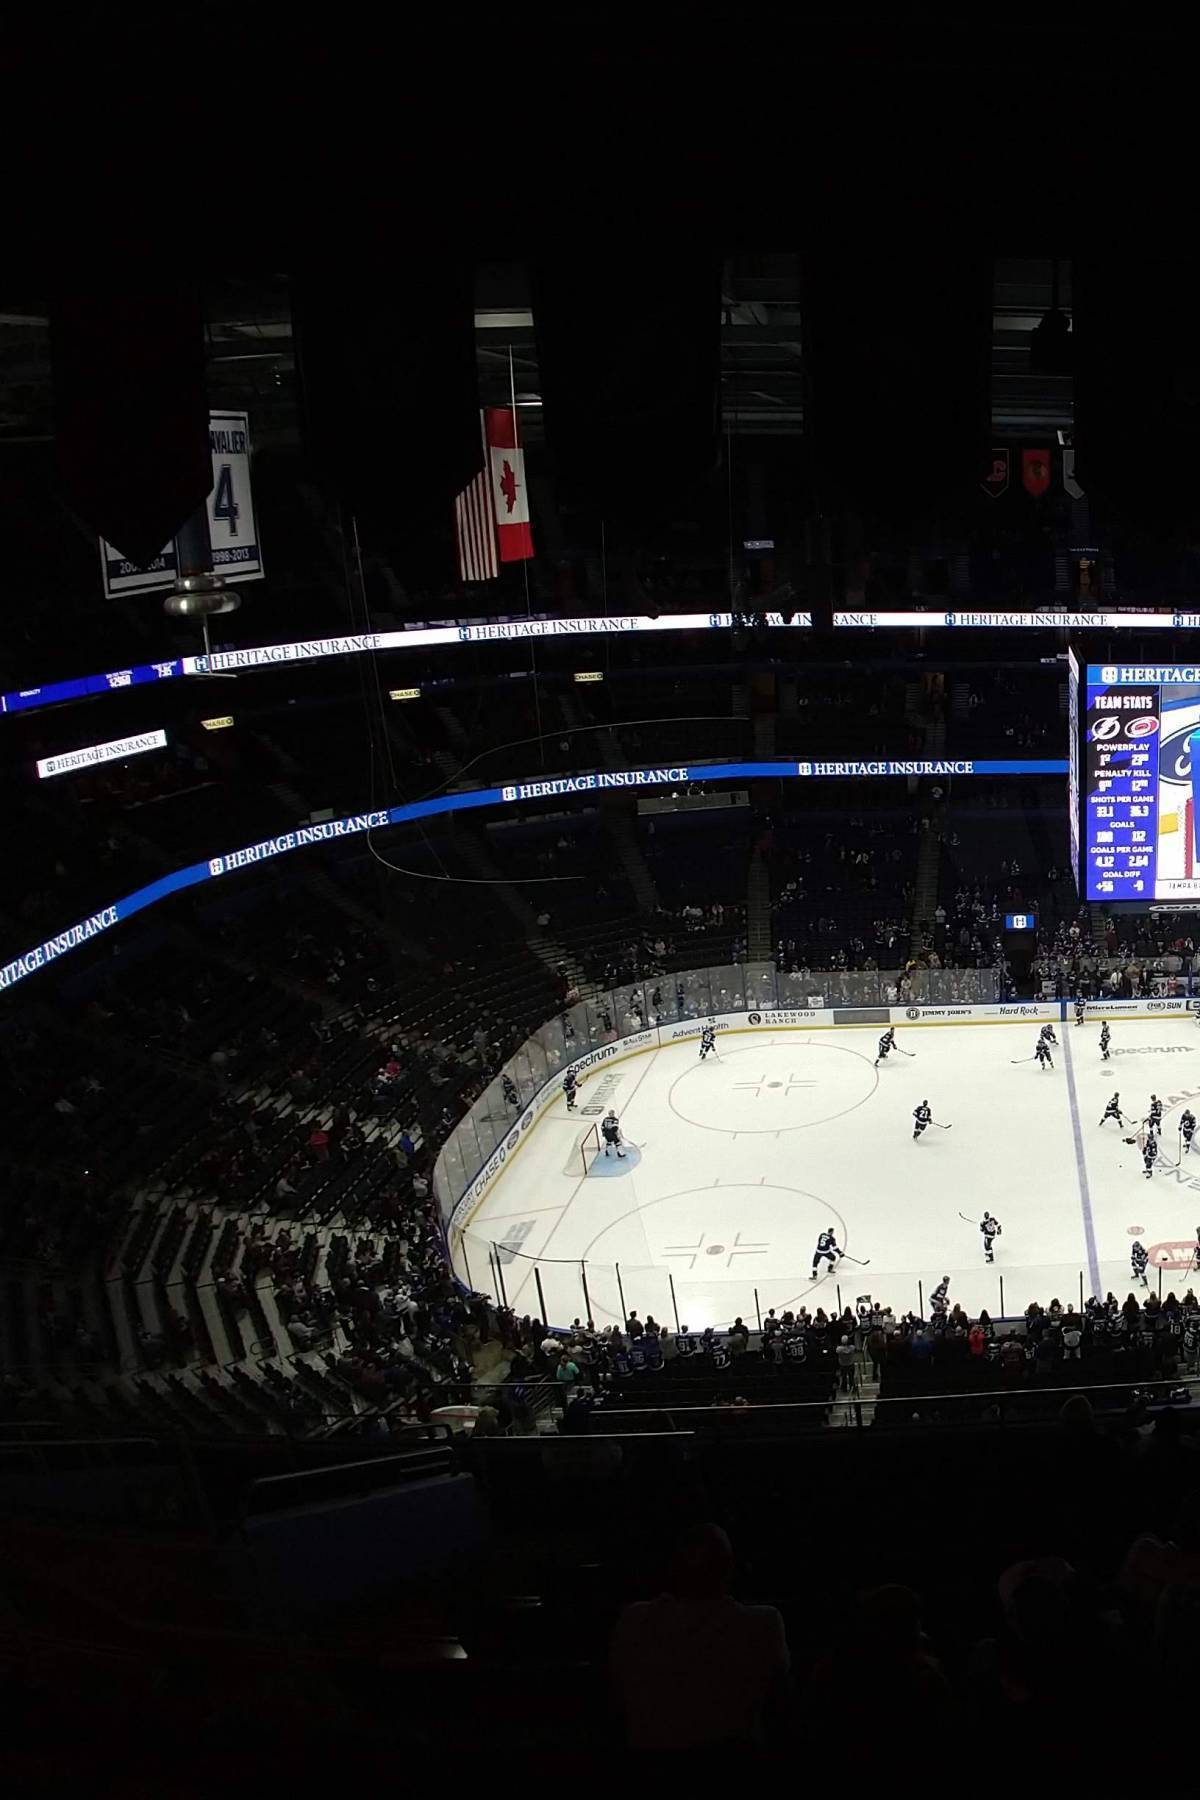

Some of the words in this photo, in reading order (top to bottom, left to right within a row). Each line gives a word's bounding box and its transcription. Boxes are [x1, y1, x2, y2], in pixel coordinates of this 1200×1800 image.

[210, 431, 245, 455] AVALIER
[213, 463, 240, 537] 4
[476, 621, 550, 640] HERITAGE
[552, 618, 639, 634] INSURANCE
[797, 613, 878, 626] INRANCE
[960, 613, 1027, 627] HERITAGE
[1030, 613, 1108, 627] INSURANCE
[212, 647, 291, 669] HERITAGE
[295, 635, 382, 658] INSURANCE
[1095, 696, 1121, 709] TEAM
[1123, 696, 1152, 709] STATS
[57, 748, 104, 770] HERITAGE
[106, 735, 159, 756] INSURANCE
[1097, 743, 1150, 752] POWERPLAY
[815, 761, 887, 776] HERITAGE
[890, 761, 974, 775] INSURANCE
[1094, 770, 1132, 778] PENALTY
[519, 777, 596, 800] HERITAGE
[598, 768, 689, 787] INSURANCE
[225, 834, 296, 870] HERITAGE
[296, 811, 389, 845] INSURANCE
[1124, 870, 1141, 878] DIFF
[0, 946, 46, 990] RITAGE
[44, 905, 119, 963] INSURANCE
[764, 1011, 816, 1019] LAKEWOOD
[1000, 1006, 1022, 1015] Hard
[1020, 1006, 1039, 1016] Rock
[567, 1045, 615, 1074] Spectrum
[474, 1155, 500, 1197] CHASE
